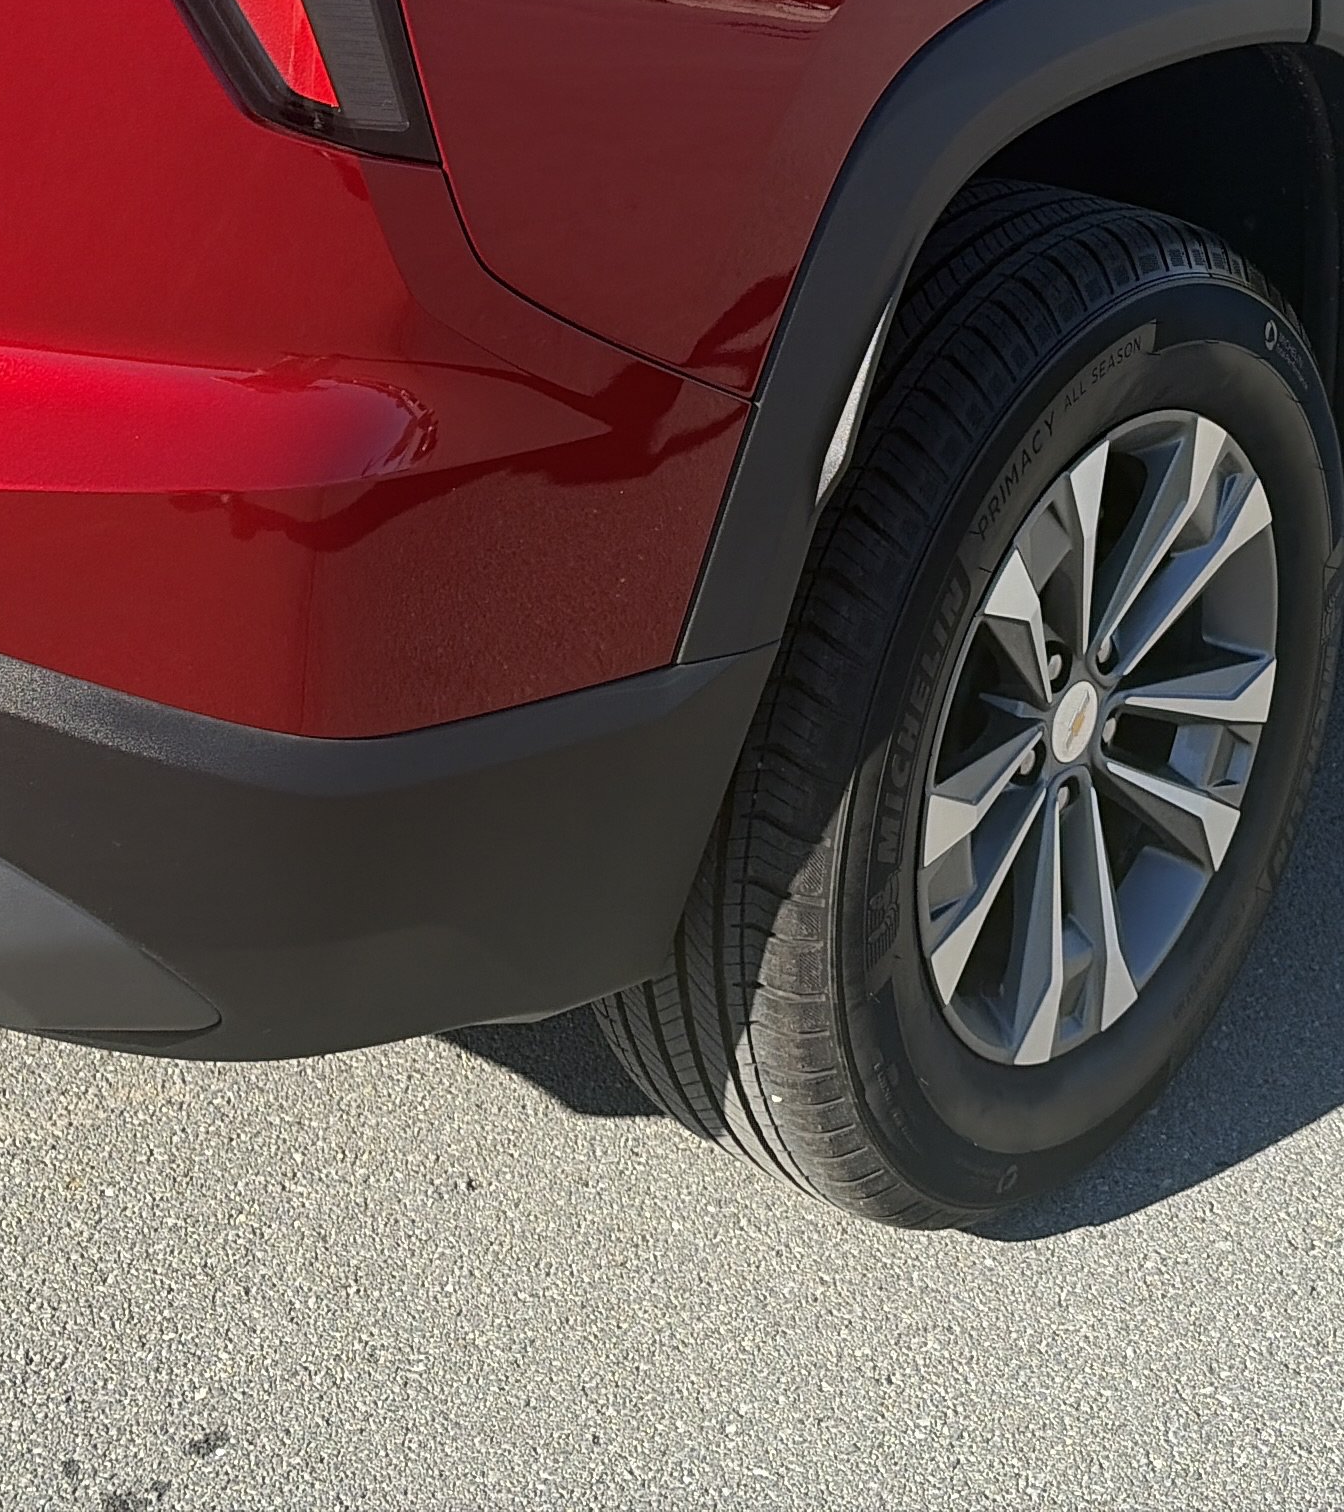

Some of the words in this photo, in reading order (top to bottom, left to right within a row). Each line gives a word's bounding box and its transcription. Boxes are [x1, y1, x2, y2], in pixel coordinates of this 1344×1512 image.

[969, 410, 1055, 541] PRIMACY
[1063, 381, 1087, 412] ALL
[1091, 336, 1142, 386] SEASON
[876, 576, 966, 865] MICHELIN
